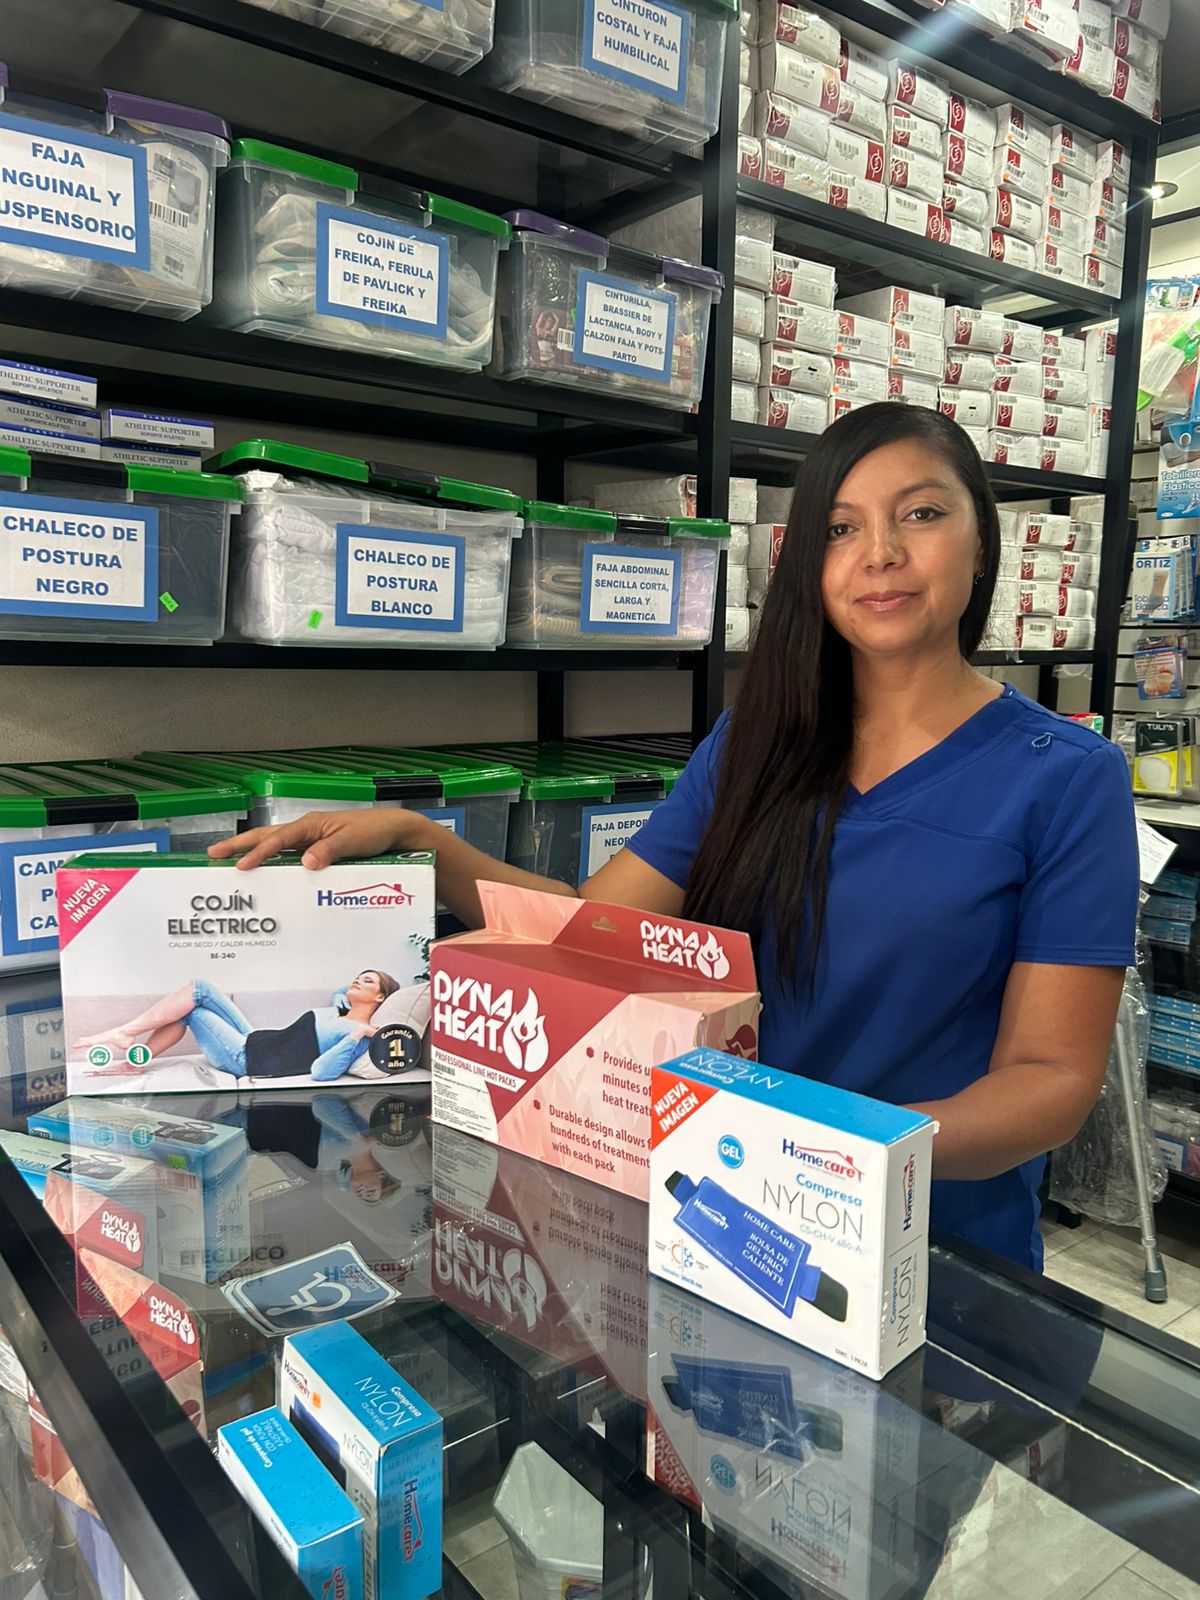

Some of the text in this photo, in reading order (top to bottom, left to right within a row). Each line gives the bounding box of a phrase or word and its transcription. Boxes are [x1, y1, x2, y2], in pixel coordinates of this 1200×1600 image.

[611, 0, 668, 27] CINTURON
[597, 11, 678, 54] COSTAL Y FAJA
[604, 35, 670, 72] HUMBILICAL
[31, 142, 86, 169] FAJA
[1, 168, 122, 207] NGUINAL Y
[357, 232, 415, 256] COJIN DE
[334, 247, 434, 281] FREIKA, FERULA
[343, 271, 426, 299] DE PAVLICK Y
[362, 296, 408, 316] FREIKA
[604, 289, 652, 310] CINTURILLA,
[602, 303, 653, 324] BRASSIER DE
[584, 329, 616, 343] CALZON
[617, 336, 636, 350] FAJA
[637, 341, 645, 350] Y
[589, 315, 663, 341] LACTANCIA, BODY Y
[612, 350, 637, 363] PARTO
[12, 381, 37, 390] SOPORTE
[35, 376, 82, 393] SUPPORTER
[6, 405, 87, 428] ATHLETIC SUPPORTER
[124, 421, 201, 437] ATHLETIC SUPPORTER
[2, 433, 87, 454] ATHLETIC SUPPORTER
[113, 452, 148, 462] ATHLETIC
[149, 456, 189, 466] SUPPORTER
[3, 515, 138, 542] CHALECO DE
[22, 546, 123, 569] POSTURA
[354, 548, 451, 569] CHALECO DE
[596, 562, 670, 576] FAJA ABDOMINAL
[1136, 556, 1171, 569] ORTIZ
[36, 577, 110, 596] NEGRO
[366, 574, 439, 592] POSTURA
[595, 578, 669, 593] SENCILLA CORTA,
[371, 600, 433, 615] BLANCO
[614, 596, 651, 606] LARGA Y
[606, 611, 656, 621] MAGNETICA
[591, 821, 616, 833] FAJA
[62, 878, 99, 912] NUEVA
[69, 884, 111, 924] IMAGEN
[191, 889, 254, 911] COJÍN
[317, 889, 405, 907] Homecare
[167, 913, 277, 935] ELÉCTRICO
[640, 919, 700, 951] DYNA
[642, 940, 696, 969] HEAT
[434, 969, 514, 1021] DYNA
[434, 1002, 504, 1053] HEAT
[389, 1039, 405, 1057] 1
[388, 1060, 405, 1068] año
[434, 1050, 517, 1088] PROFESSIONAL LINE HOT PACKS
[603, 1051, 643, 1074] Provides
[686, 1053, 784, 1090] NYLON
[602, 1073, 641, 1094] minutes
[602, 1090, 624, 1109] heat
[653, 1080, 690, 1117] NUEVA
[658, 1092, 700, 1133] IMAGEN
[549, 1104, 583, 1127] Durable
[584, 1117, 614, 1139] design
[615, 1129, 646, 1149] allows
[550, 1122, 591, 1147] hundreds
[592, 1138, 601, 1151] of
[551, 1141, 616, 1173] with each pack
[721, 1142, 741, 1161] GEL
[782, 1137, 856, 1179] Homecare
[795, 1173, 863, 1208] Compresa
[903, 1160, 916, 1232] Homecare
[101, 1210, 130, 1233] DYNA
[763, 1177, 863, 1242] NYLON
[101, 1224, 127, 1246] HEAT
[743, 1210, 797, 1252] HOME CARE
[745, 1240, 762, 1258] GEL
[763, 1251, 784, 1274] FRIO
[749, 1232, 775, 1257] BOLSA
[777, 1252, 790, 1266] DE
[741, 1249, 785, 1287] CALIENTE
[150, 1295, 182, 1321] DYNA
[889, 1267, 899, 1325] Compresa
[897, 1256, 913, 1348] NYLON
[150, 1310, 181, 1335] HEAT
[353, 1375, 413, 1428] NYLON
[391, 1386, 423, 1418] Compresa
